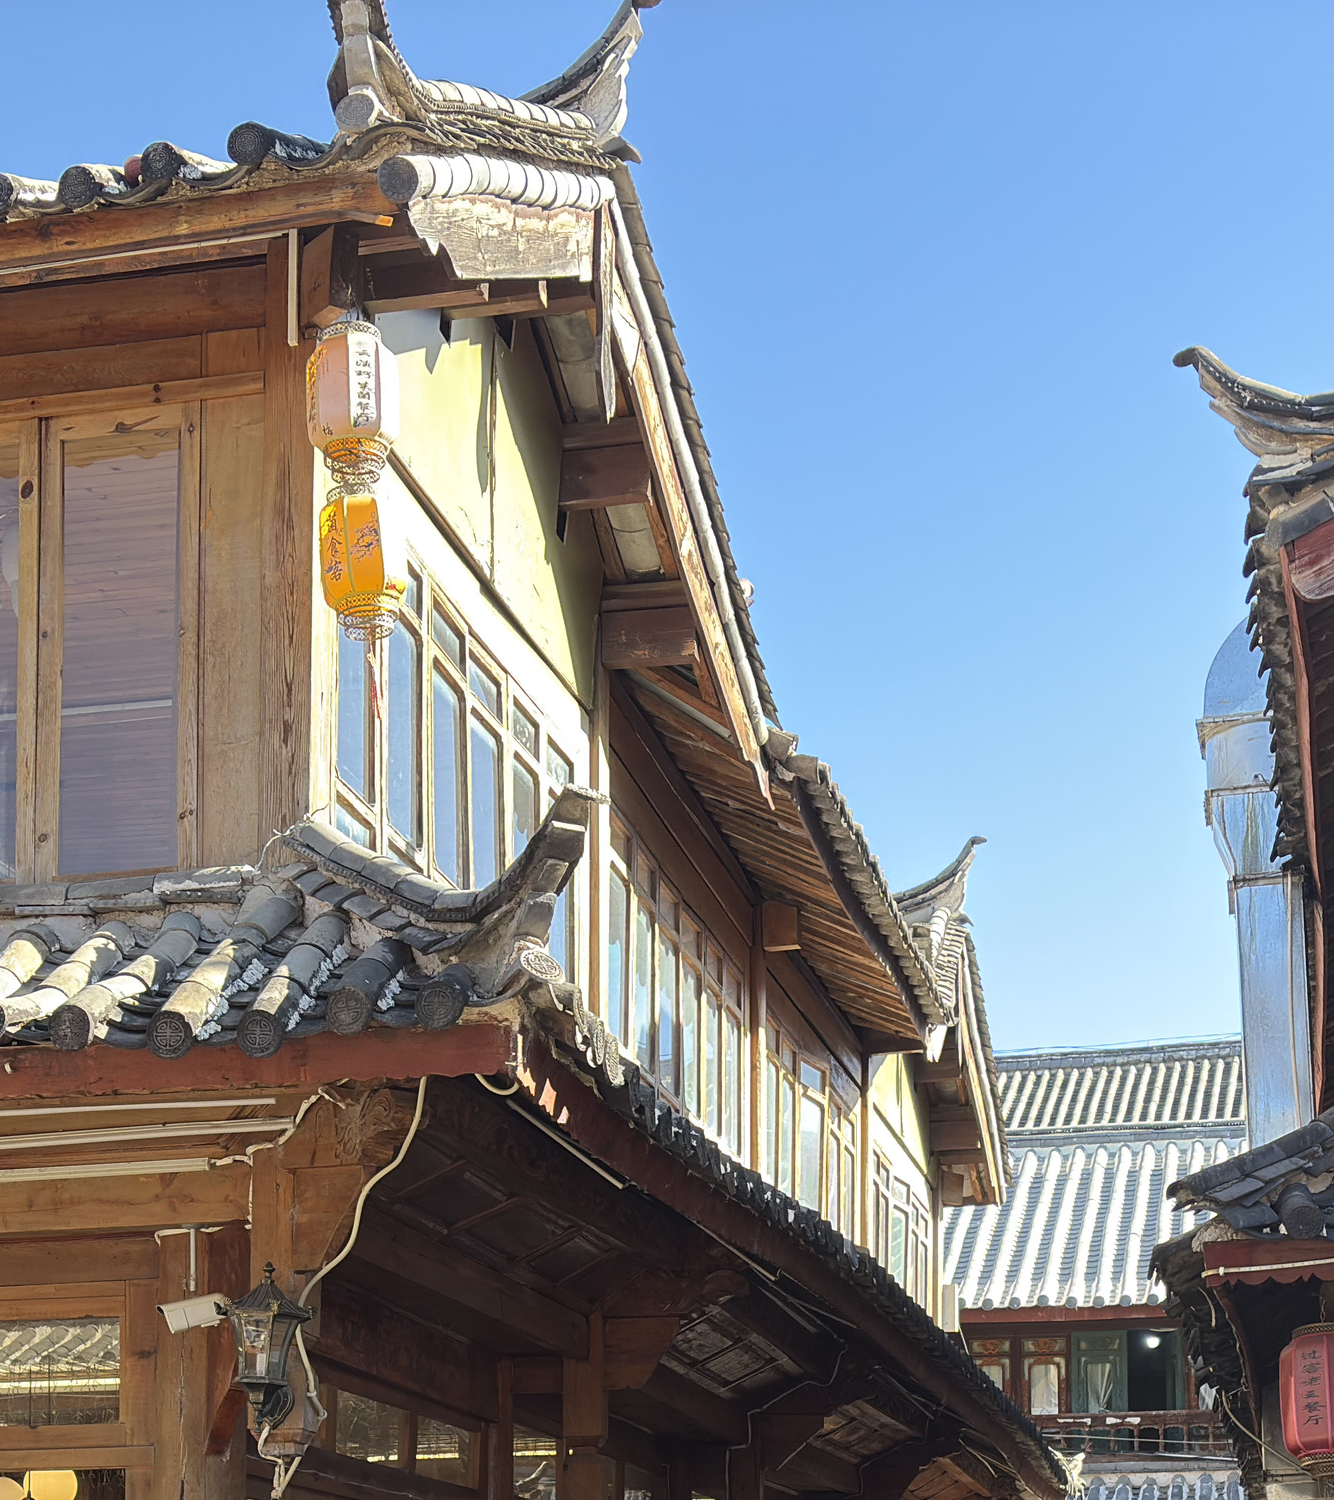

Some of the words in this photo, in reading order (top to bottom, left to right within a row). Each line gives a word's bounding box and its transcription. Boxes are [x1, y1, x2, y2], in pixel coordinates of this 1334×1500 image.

[1297, 1350, 1326, 1426] 过客老王餐厅
